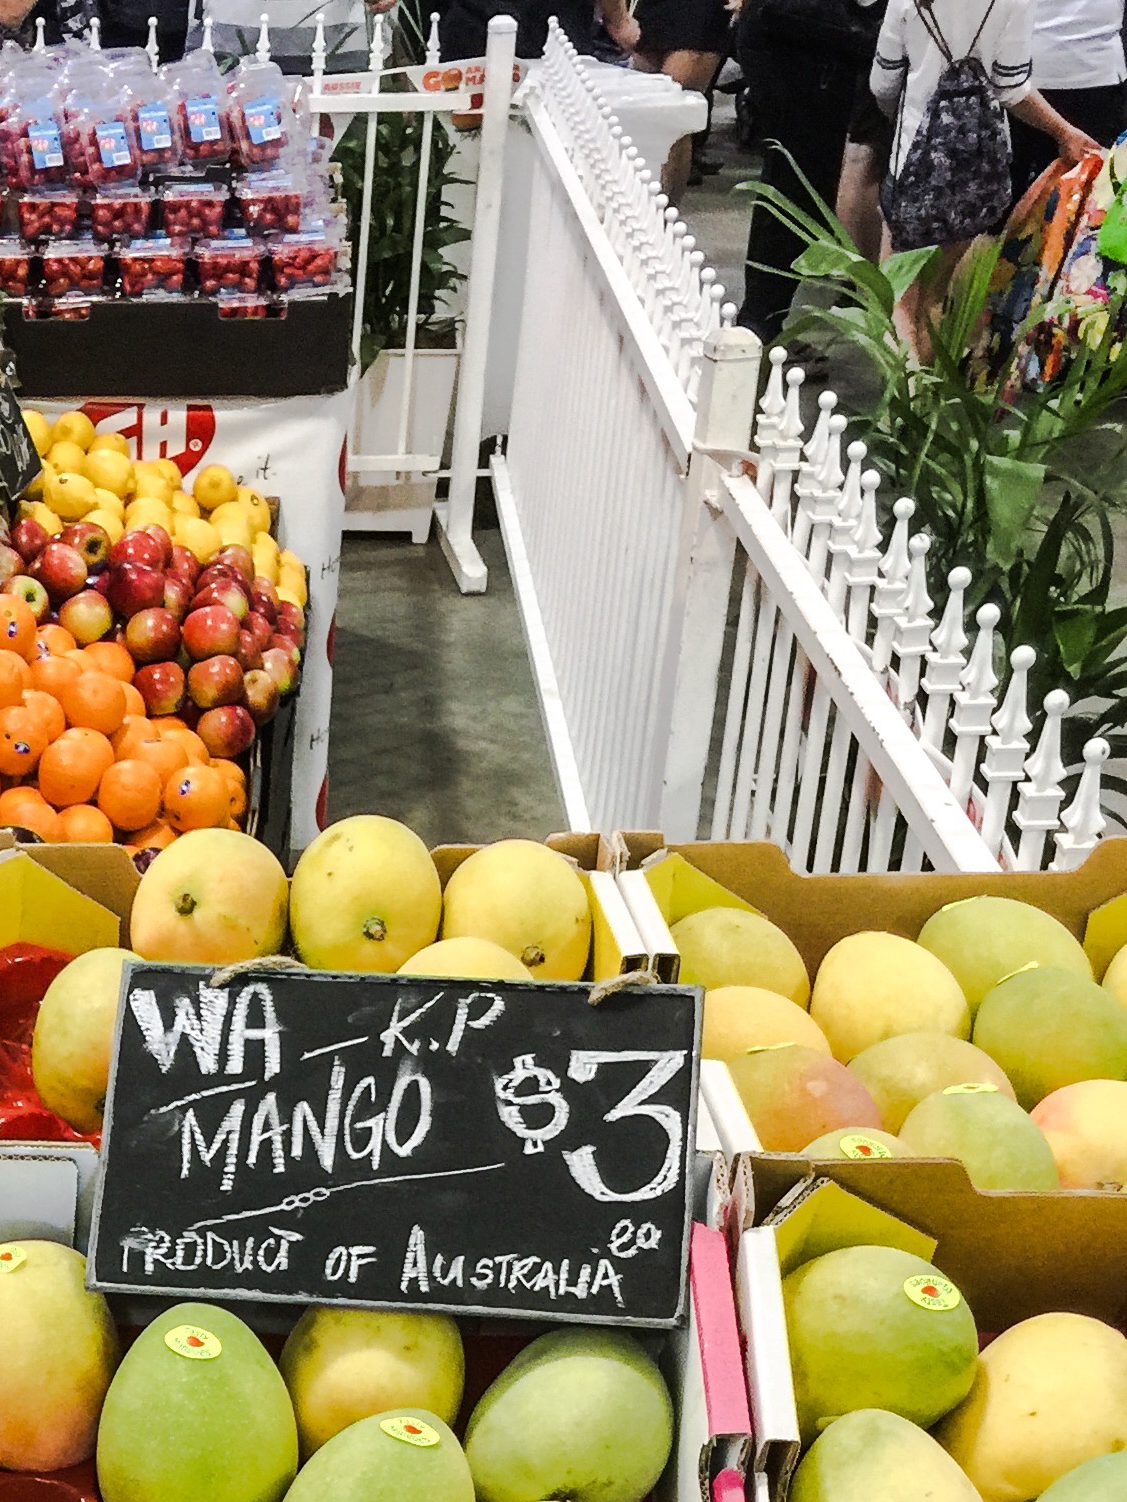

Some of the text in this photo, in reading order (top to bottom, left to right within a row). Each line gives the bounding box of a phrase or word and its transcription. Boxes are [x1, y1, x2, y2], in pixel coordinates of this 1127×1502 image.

[129, 981, 284, 1082] WA
[180, 1056, 432, 1192] MANGO
[496, 1050, 688, 1202] $3
[120, 1226, 304, 1275] PRODUCT
[326, 1245, 377, 1283] OF
